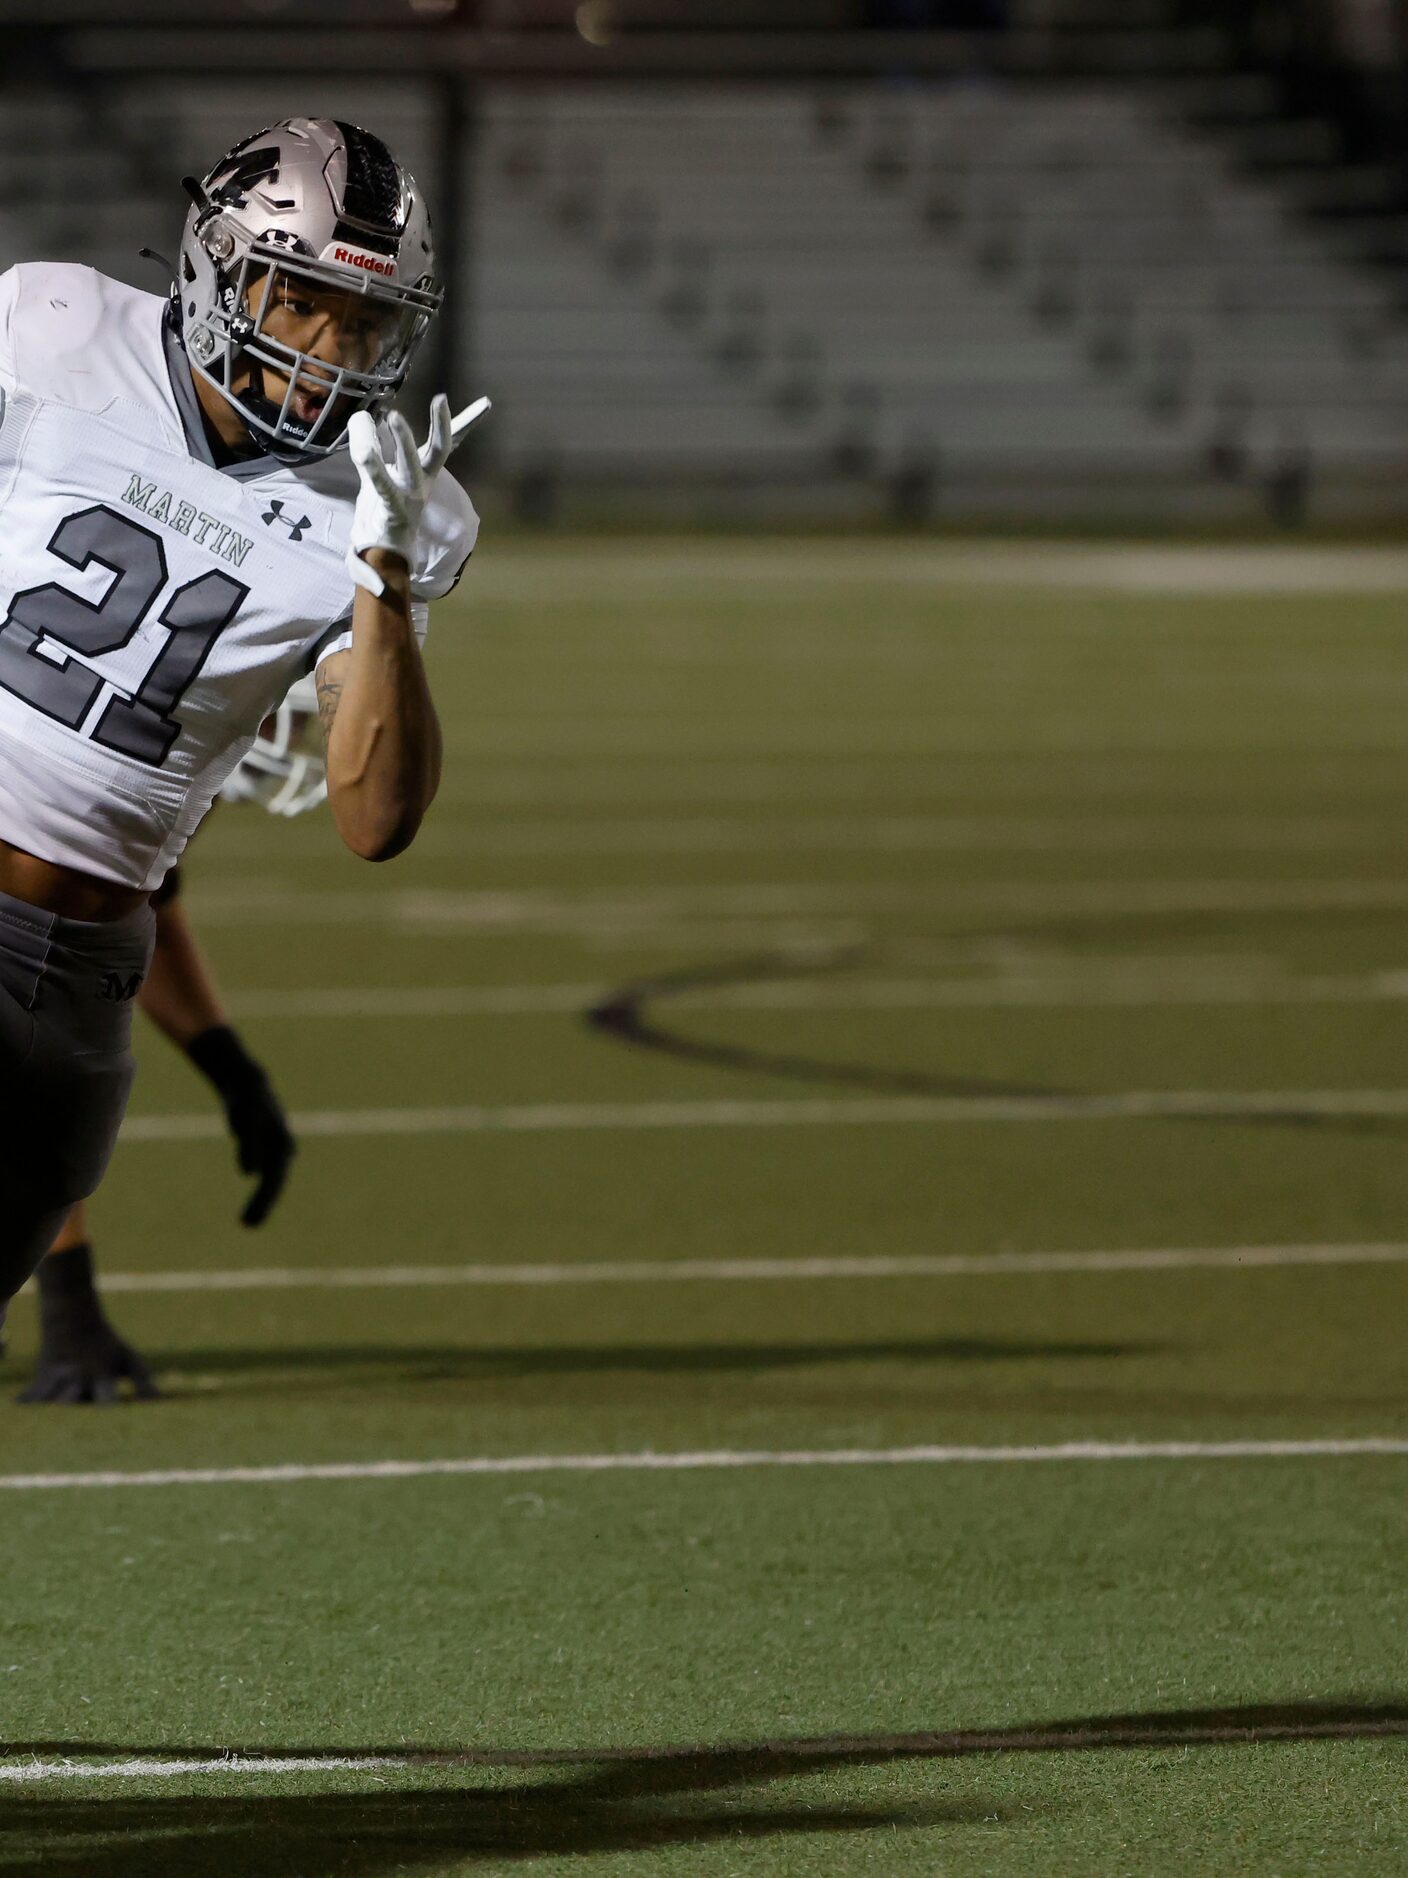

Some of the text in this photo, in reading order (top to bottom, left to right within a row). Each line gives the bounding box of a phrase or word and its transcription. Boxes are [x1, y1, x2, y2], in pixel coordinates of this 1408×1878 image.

[334, 248, 394, 277] Riddell
[282, 422, 309, 438] Ridde
[121, 474, 255, 568] MARTIN
